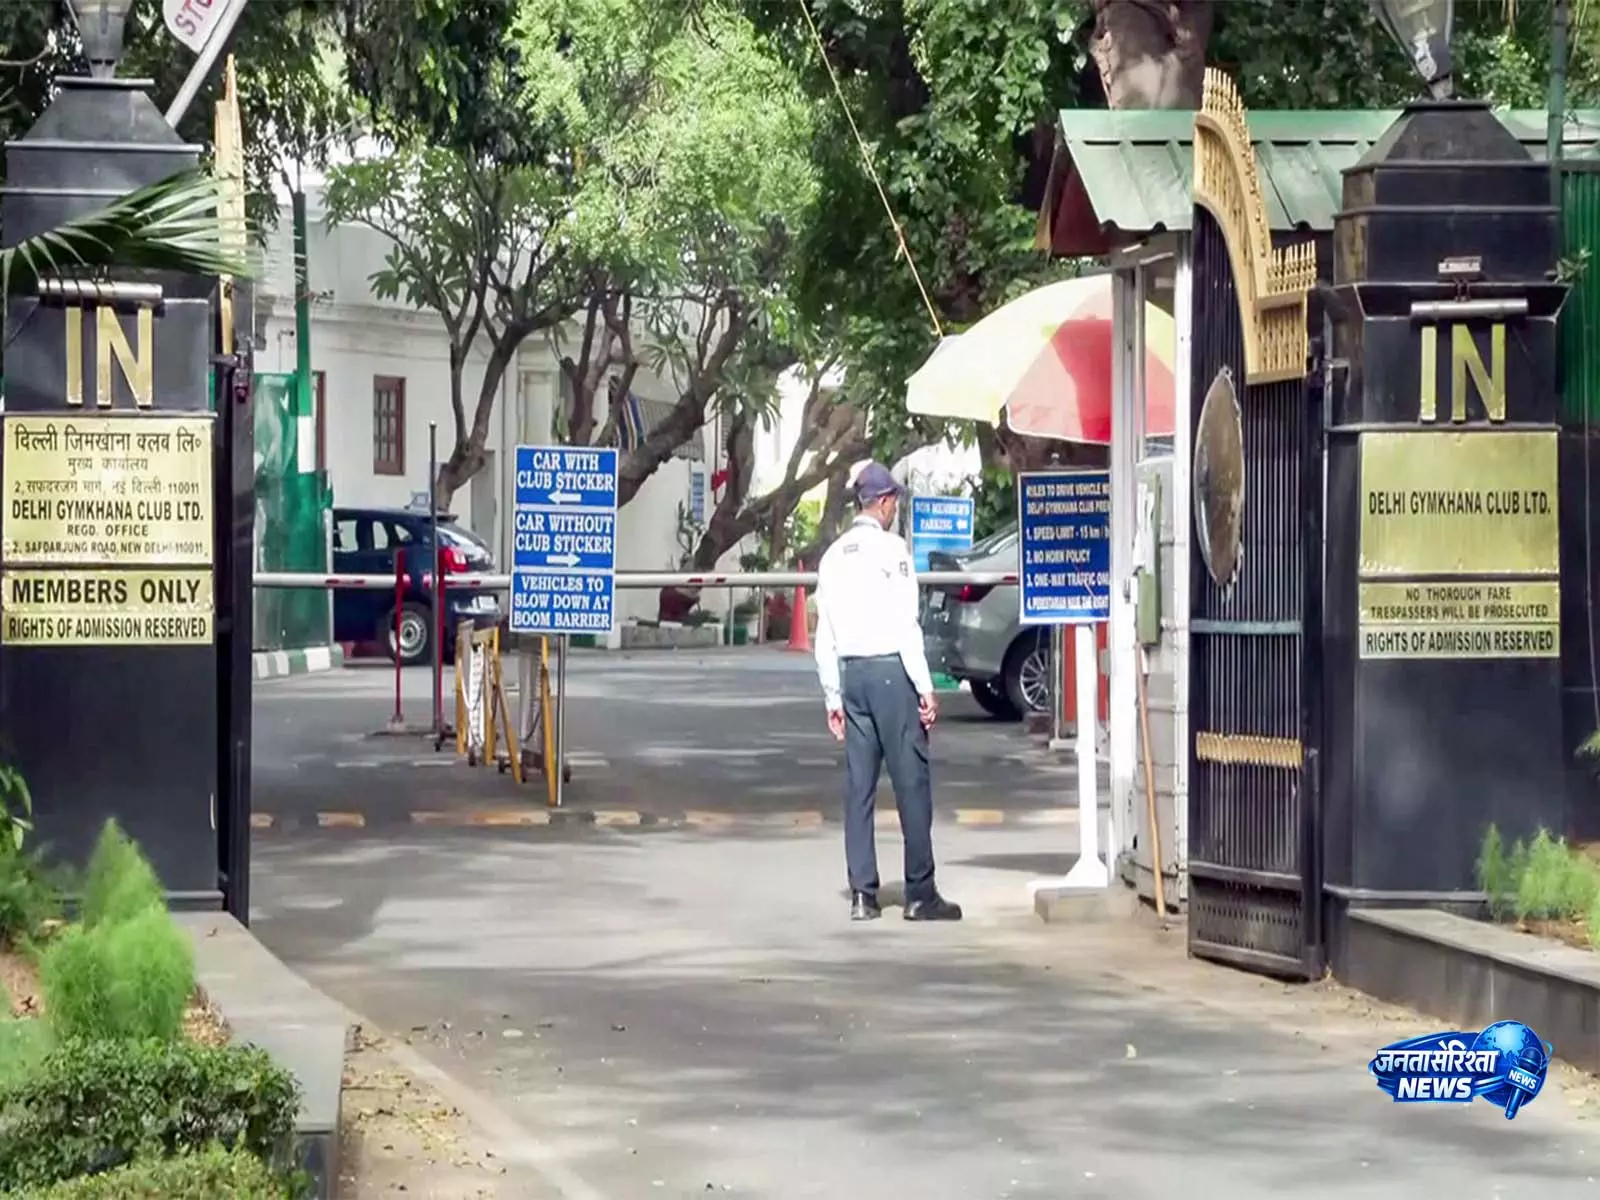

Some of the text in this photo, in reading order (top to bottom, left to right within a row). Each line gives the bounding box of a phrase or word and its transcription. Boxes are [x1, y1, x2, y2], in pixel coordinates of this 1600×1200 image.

[66, 306, 152, 405] IN
[1421, 324, 1505, 420] IN
[15, 424, 58, 450] दिल्ली
[64, 424, 131, 450] जिमखाना
[533, 452, 599, 471] CAR WITH
[518, 471, 614, 491] CLUB STICKER
[12, 499, 204, 520] DELHI GYMKHANA CLUB LTD.
[1369, 491, 1551, 514] DELHI GYMKHANA CLUB LTD.
[105, 524, 149, 537] OFFICE
[516, 514, 613, 533] CAR WITHOUT
[1034, 526, 1055, 540] SPEED
[1055, 526, 1075, 539] LIMIT
[25, 541, 88, 553] SAFDARJUNG
[121, 541, 141, 554] NEW
[516, 533, 612, 554] CLUB STICKER
[1034, 550, 1044, 564] NO
[1045, 550, 1065, 564] HORN
[1066, 549, 1090, 562] POLICY
[522, 575, 604, 591] VEHICLES TO
[1034, 573, 1066, 587] ONE-WAY
[1068, 572, 1096, 586] TRAFFIC
[12, 579, 200, 603] MEMBERS ONLY
[1406, 587, 1511, 600] NO THOROUGH FARE
[515, 593, 610, 610] SLOW DOWN AT
[513, 610, 610, 628] BOOM BARRIER
[1371, 604, 1548, 619] TRESPASSERS WILL BE PROSECUTED
[9, 617, 206, 638] RIGHTS OF ADMISSION RESERVED
[1366, 631, 1553, 653] RIGHTS OF ADMISSION RESERVED
